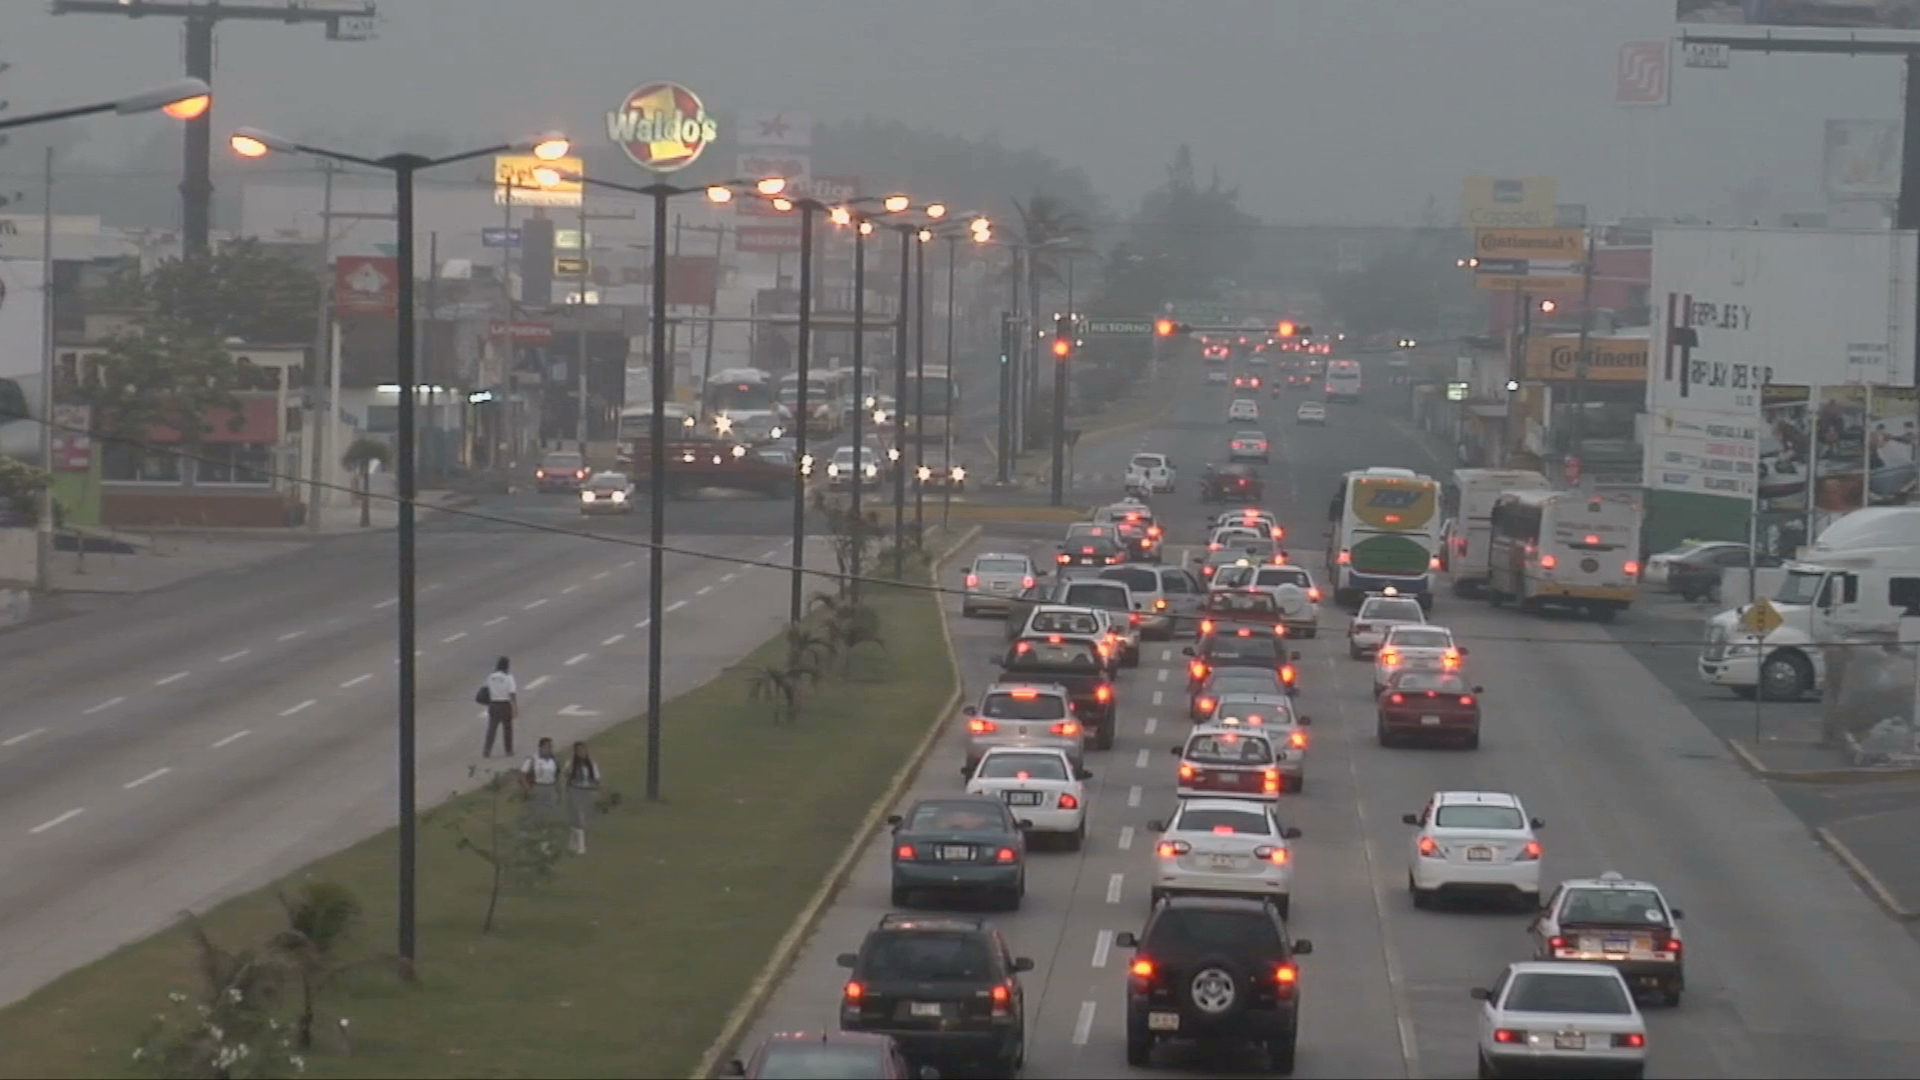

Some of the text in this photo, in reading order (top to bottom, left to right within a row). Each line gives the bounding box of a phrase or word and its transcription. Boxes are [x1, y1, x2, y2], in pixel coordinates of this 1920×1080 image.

[606, 108, 717, 143] Waldo's
[1481, 233, 1564, 252] Continental
[1091, 322, 1152, 334] RETORNO
